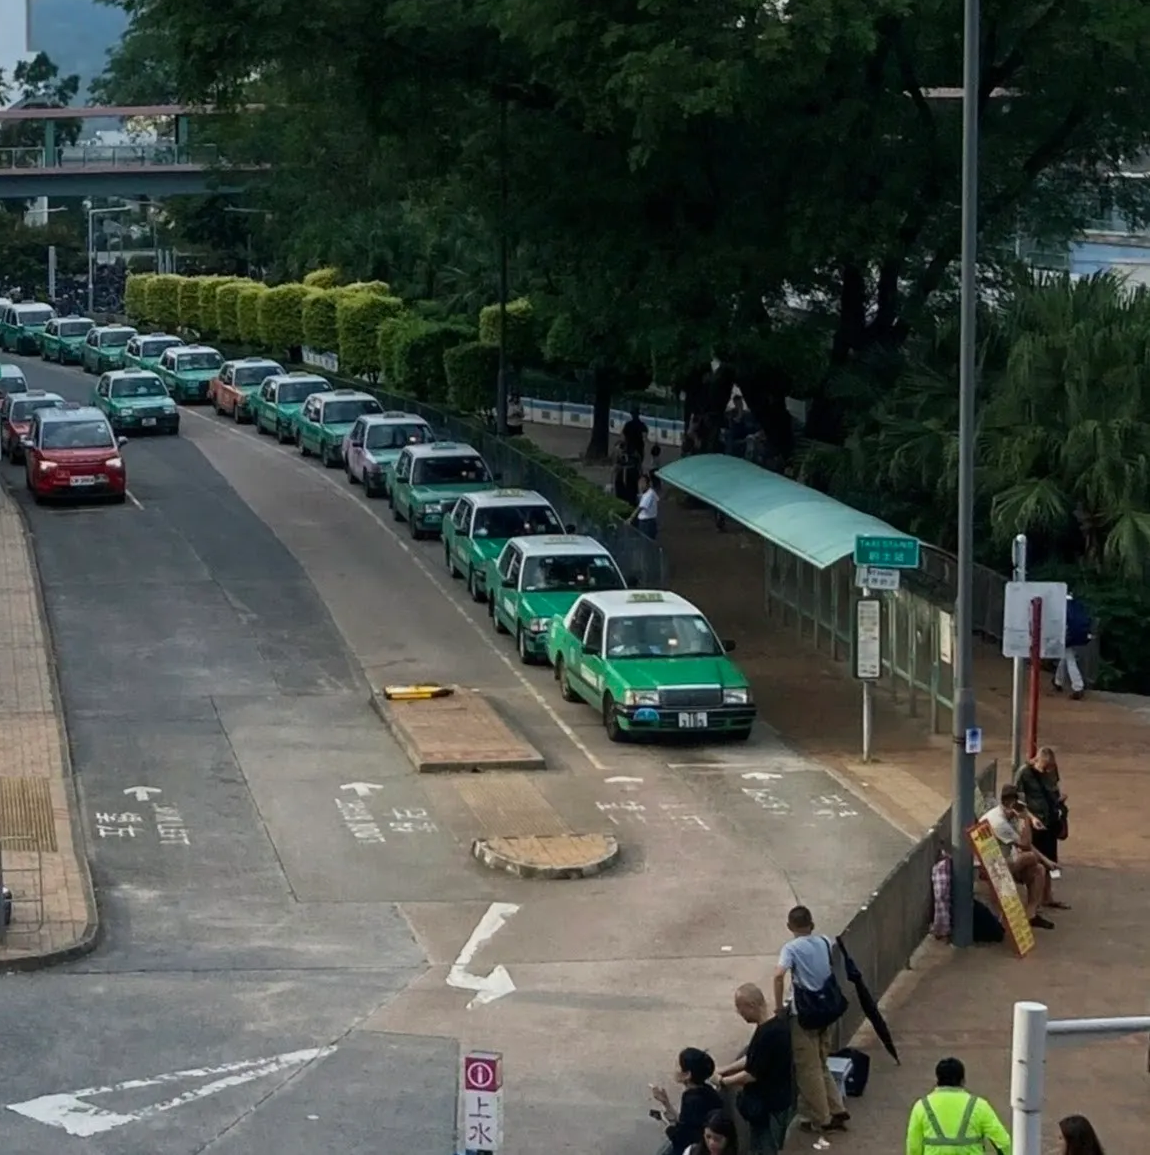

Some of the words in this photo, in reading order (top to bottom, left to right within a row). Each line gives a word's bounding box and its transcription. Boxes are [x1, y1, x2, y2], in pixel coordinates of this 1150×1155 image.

[859, 539, 880, 549] TAXI
[882, 540, 914, 549] STAND
[868, 551, 905, 562] 的士站
[632, 592, 663, 602] TAXI
[95, 812, 146, 838] 望左
[468, 1096, 493, 1145] 上水
